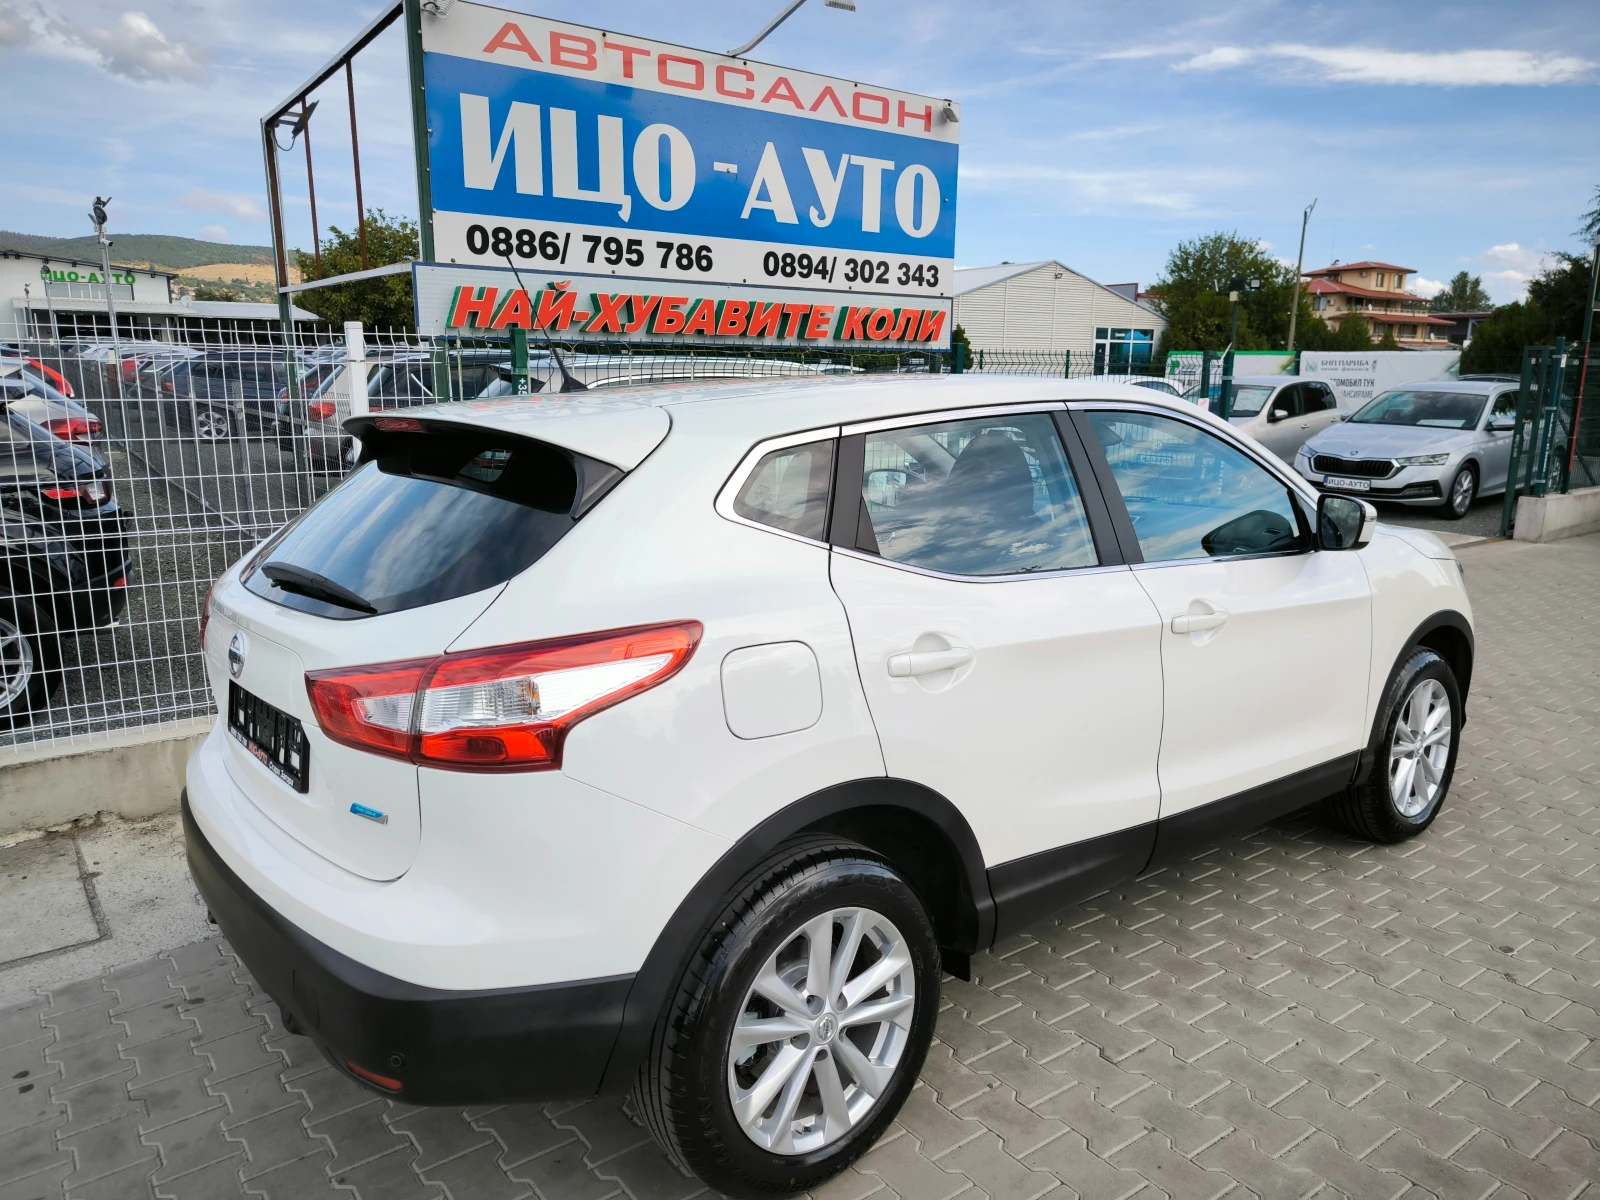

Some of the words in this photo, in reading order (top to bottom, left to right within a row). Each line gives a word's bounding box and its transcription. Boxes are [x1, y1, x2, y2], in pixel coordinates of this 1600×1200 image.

[482, 21, 933, 133] АВТОСАЛОН
[465, 223, 571, 265] 0886/
[582, 233, 645, 268] 795
[656, 240, 714, 273] 786
[763, 250, 838, 284] 0894/
[844, 257, 890, 285] 302
[896, 262, 940, 288] 343
[447, 279, 836, 341] НАЙ-ХУБАВИТЕ
[836, 305, 947, 343] КОЛИ
